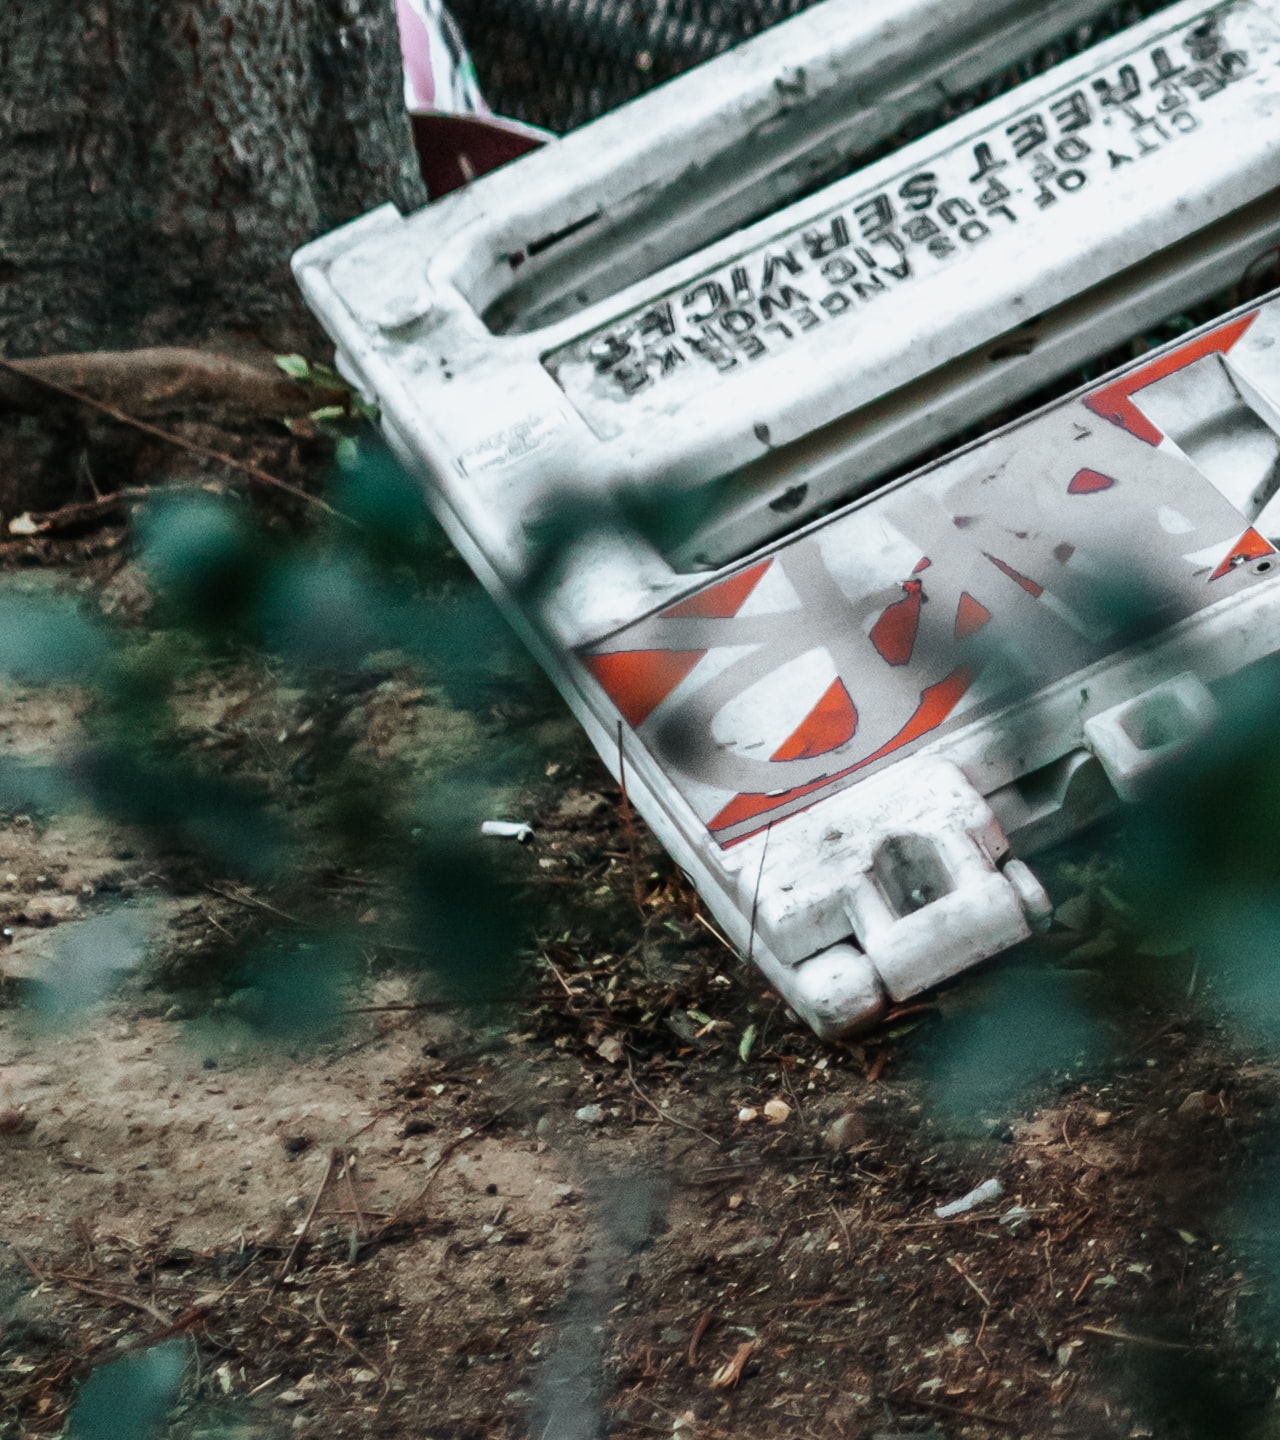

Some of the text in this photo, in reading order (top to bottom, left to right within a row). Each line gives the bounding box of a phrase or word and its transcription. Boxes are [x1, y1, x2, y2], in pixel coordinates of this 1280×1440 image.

[585, 17, 1225, 376] STREET SERVICES
[1032, 128, 1092, 184] OF
[706, 108, 1197, 372] CITY OF LOS ANGELES
[820, 175, 1010, 286] PUBLIC
[612, 284, 809, 398] WORKS
